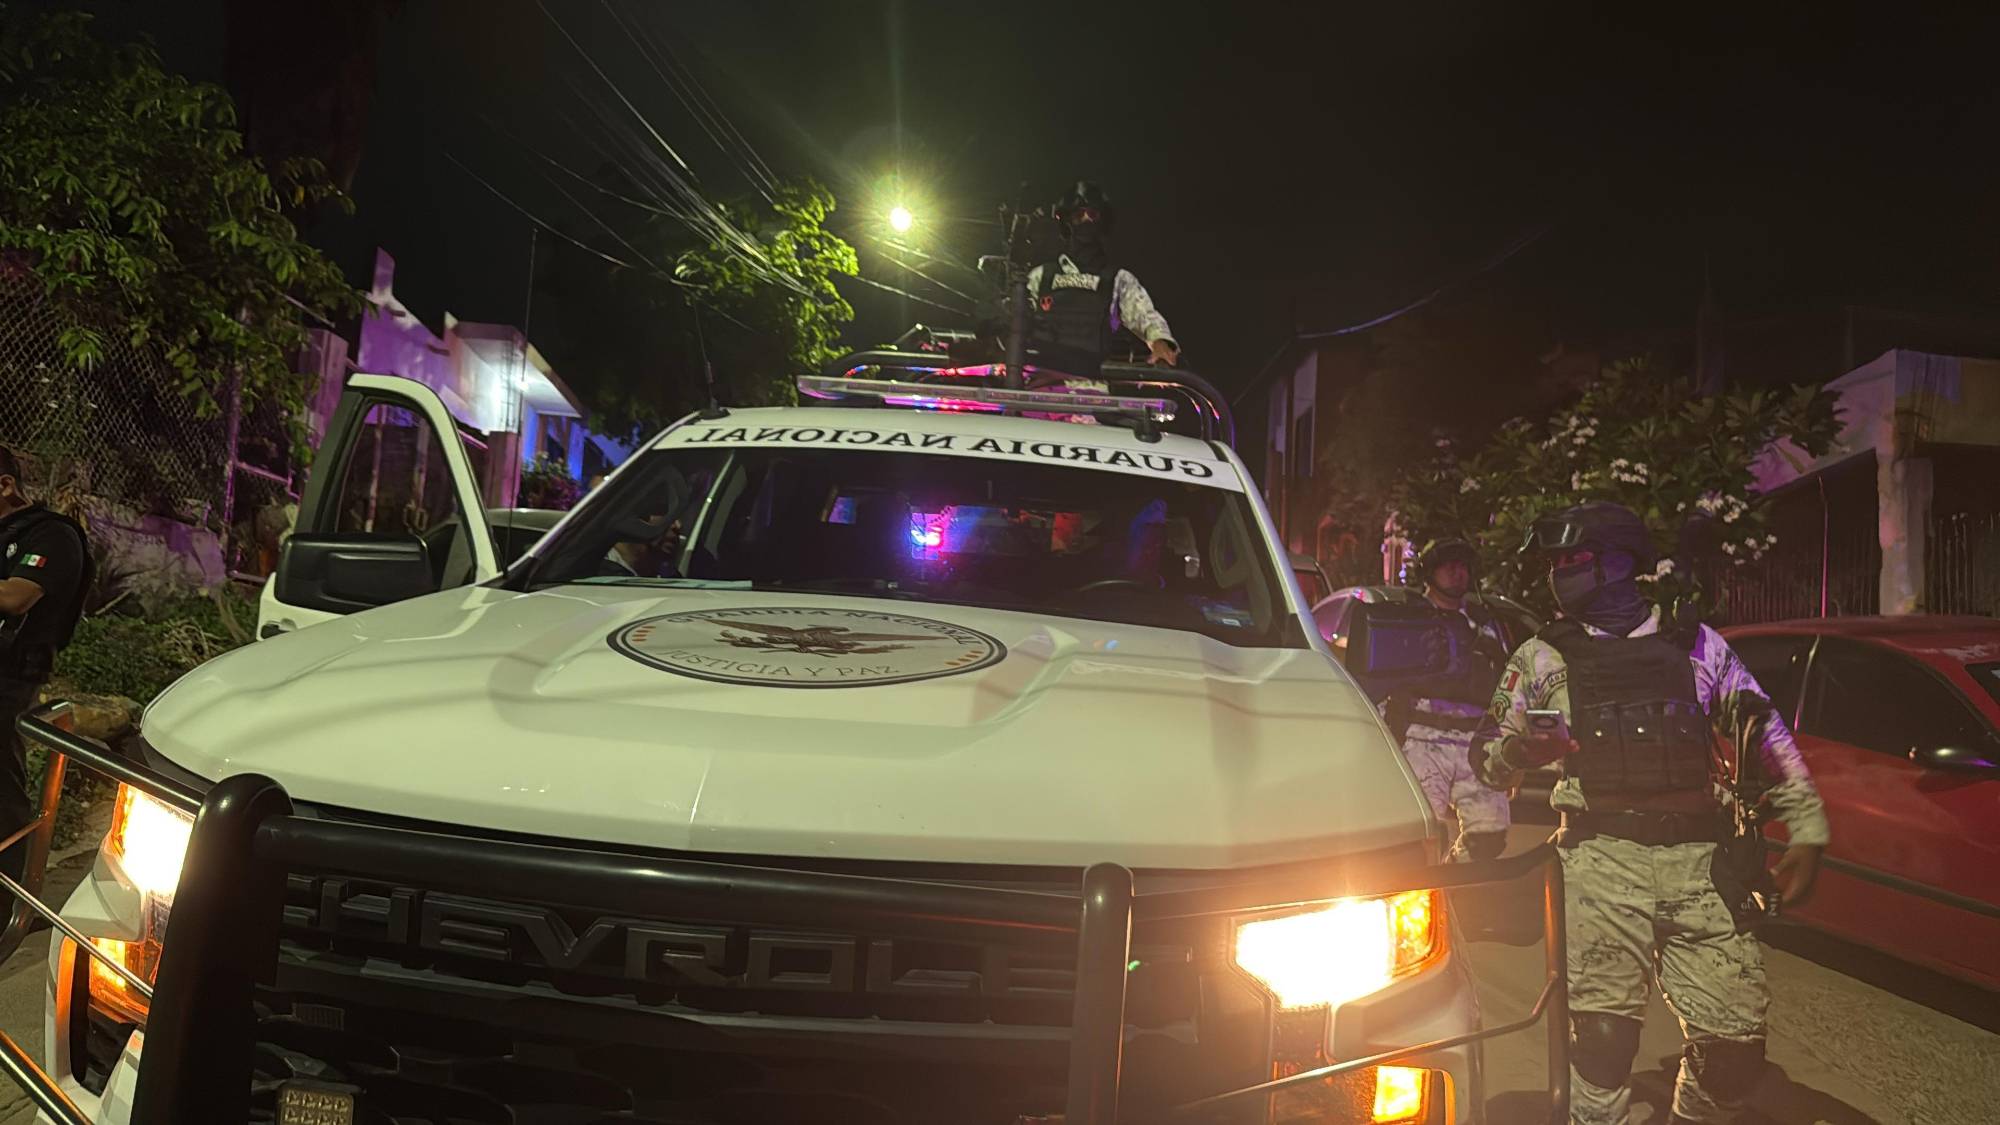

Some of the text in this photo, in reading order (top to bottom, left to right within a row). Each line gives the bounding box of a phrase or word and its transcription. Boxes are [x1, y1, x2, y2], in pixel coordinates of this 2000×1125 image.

[657, 649, 898, 677] JUSTICIA Y PAZ
